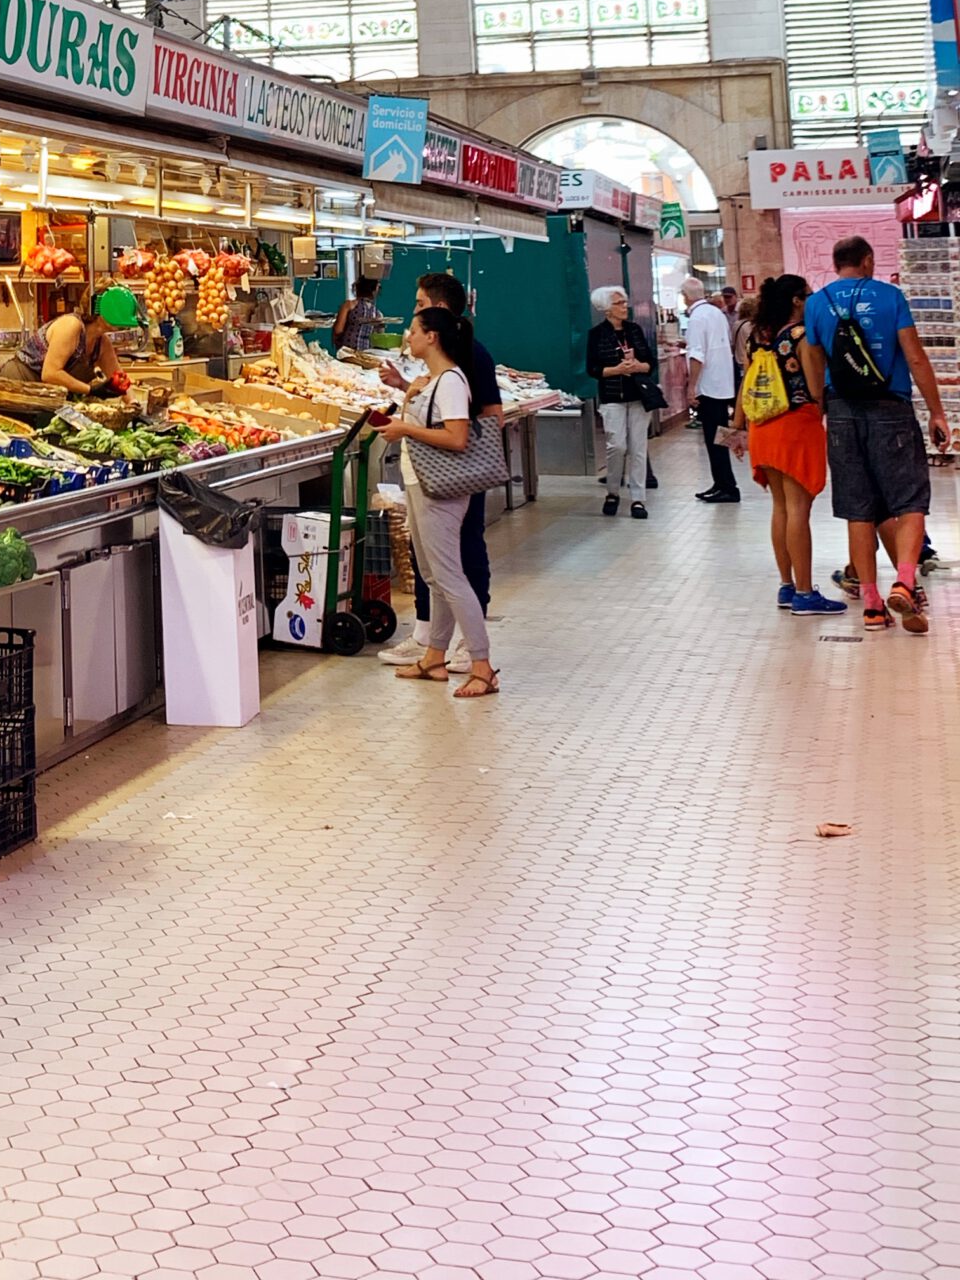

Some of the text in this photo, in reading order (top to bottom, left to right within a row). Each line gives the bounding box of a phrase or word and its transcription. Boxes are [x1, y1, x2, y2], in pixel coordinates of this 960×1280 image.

[153, 44, 239, 118] VIRGINIA
[247, 76, 308, 135] LACTEOS
[306, 95, 318, 137] Y
[371, 103, 425, 120] Servicio a
[372, 119, 423, 132] domicilio
[782, 187, 850, 197] CARNISSERS
[876, 185, 896, 193] DEL
